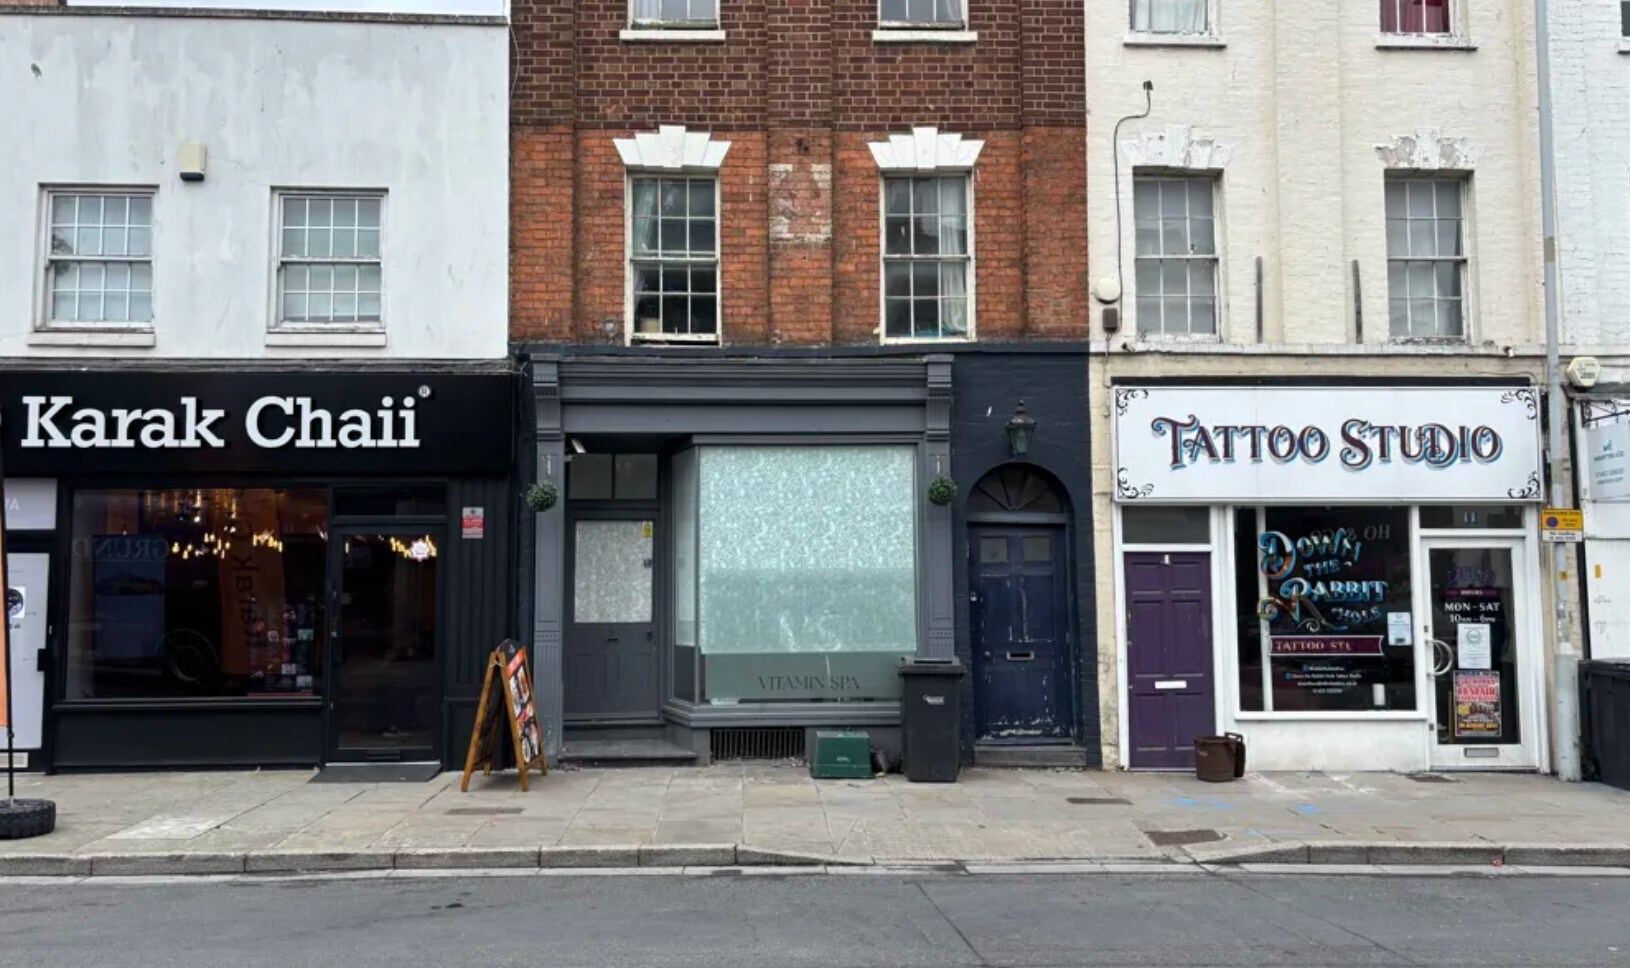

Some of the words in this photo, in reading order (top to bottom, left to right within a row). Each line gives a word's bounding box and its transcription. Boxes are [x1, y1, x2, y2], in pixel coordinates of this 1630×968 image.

[21, 396, 225, 449] Karak
[245, 395, 421, 449] Chaii
[1151, 414, 1330, 471] TATTOO
[1340, 418, 1503, 471] STUDIO
[1258, 528, 1362, 580] DOWN
[1303, 559, 1340, 577] THE
[1275, 640, 1325, 652] TATTOO
[758, 676, 825, 690] VITAMIN
[830, 676, 861, 690] SPA
